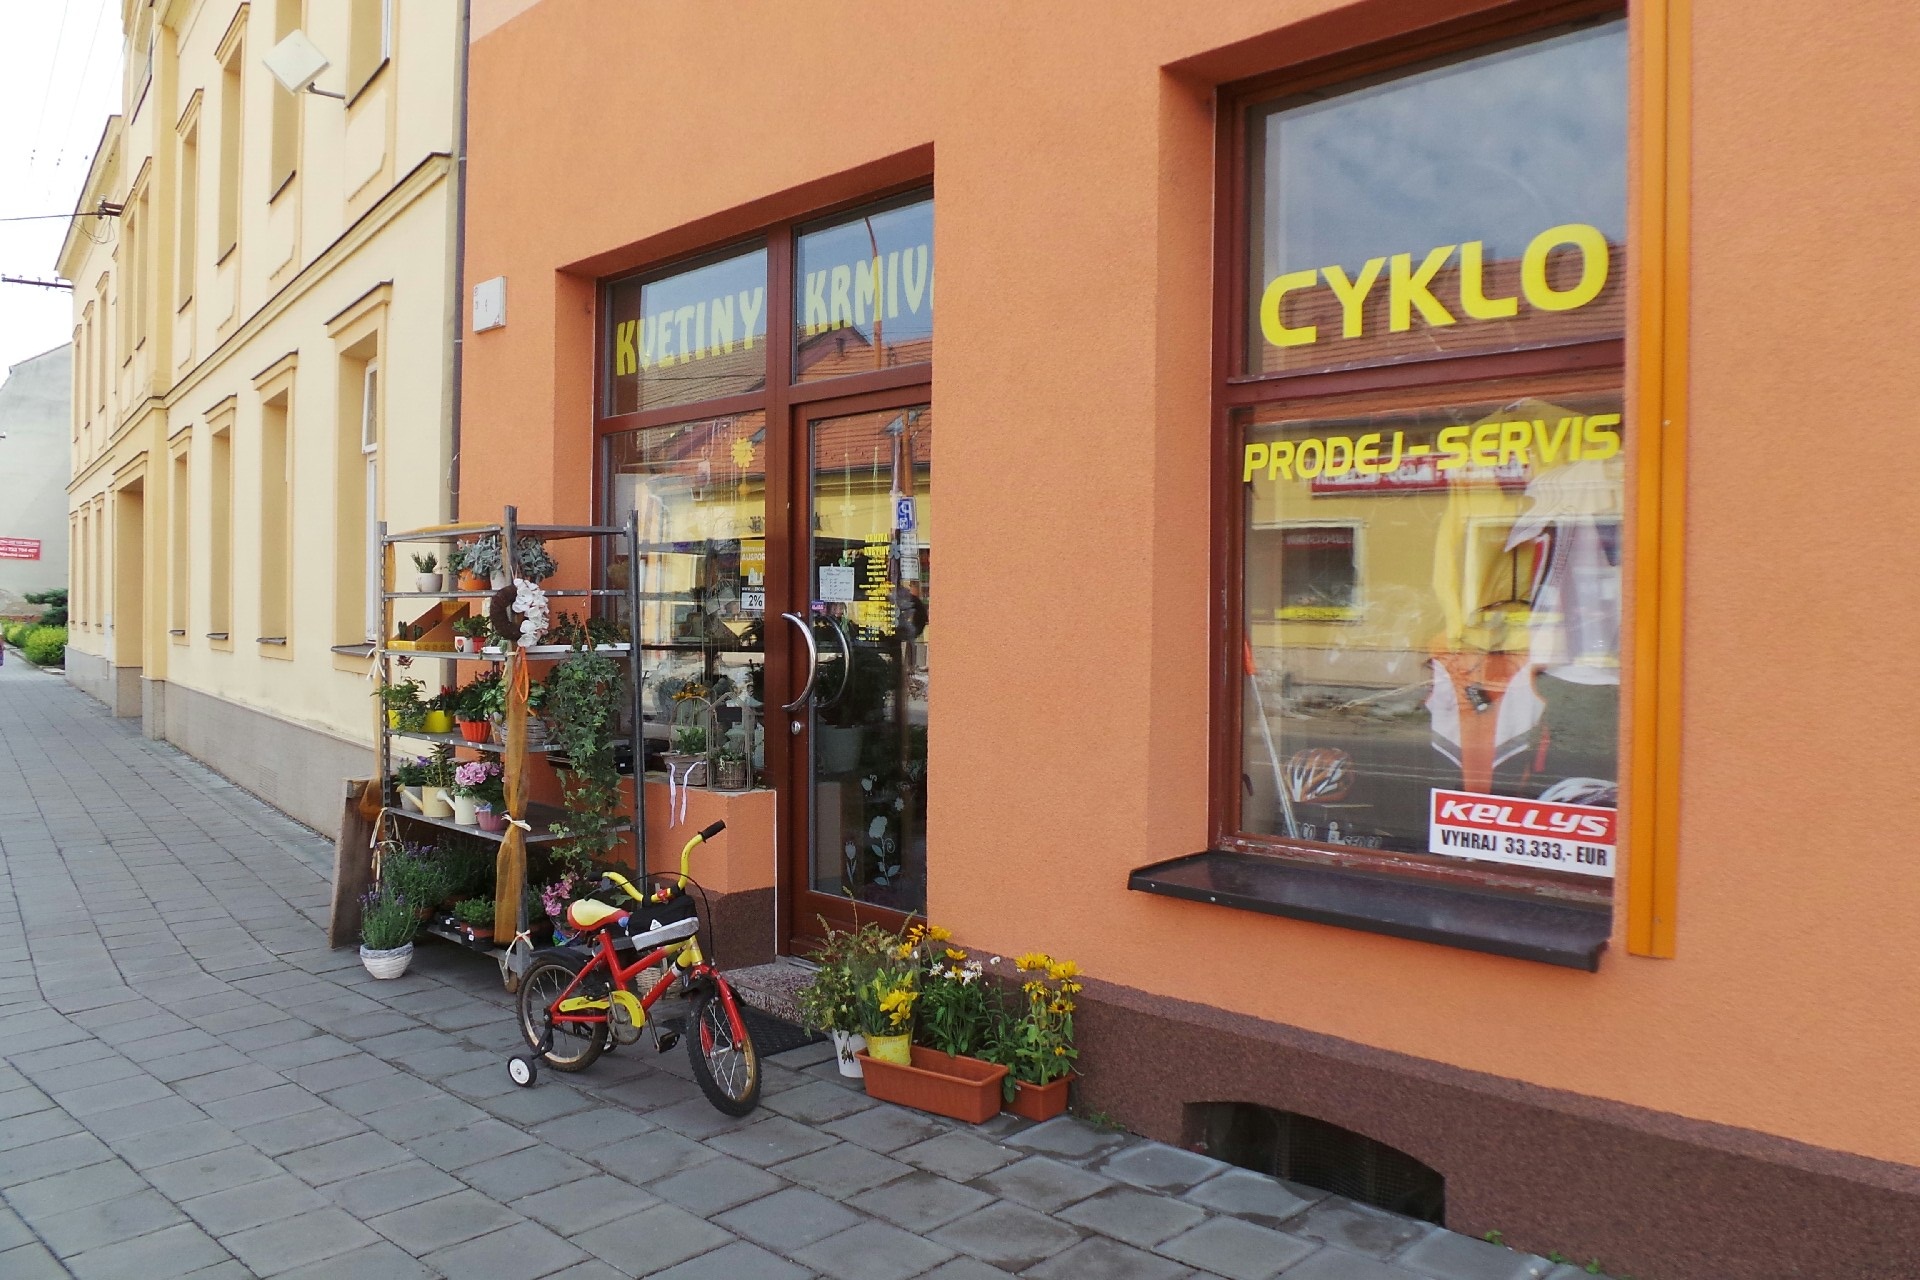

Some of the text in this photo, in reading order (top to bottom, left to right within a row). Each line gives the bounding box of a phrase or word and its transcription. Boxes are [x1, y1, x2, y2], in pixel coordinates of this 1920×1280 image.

[615, 243, 934, 377] KVETINY KRMIV
[1259, 223, 1610, 348] CYKLO
[1440, 800, 1611, 838] KELLYS
[1441, 829, 1497, 851] VYHRAJ
[1576, 846, 1608, 866] EUR
